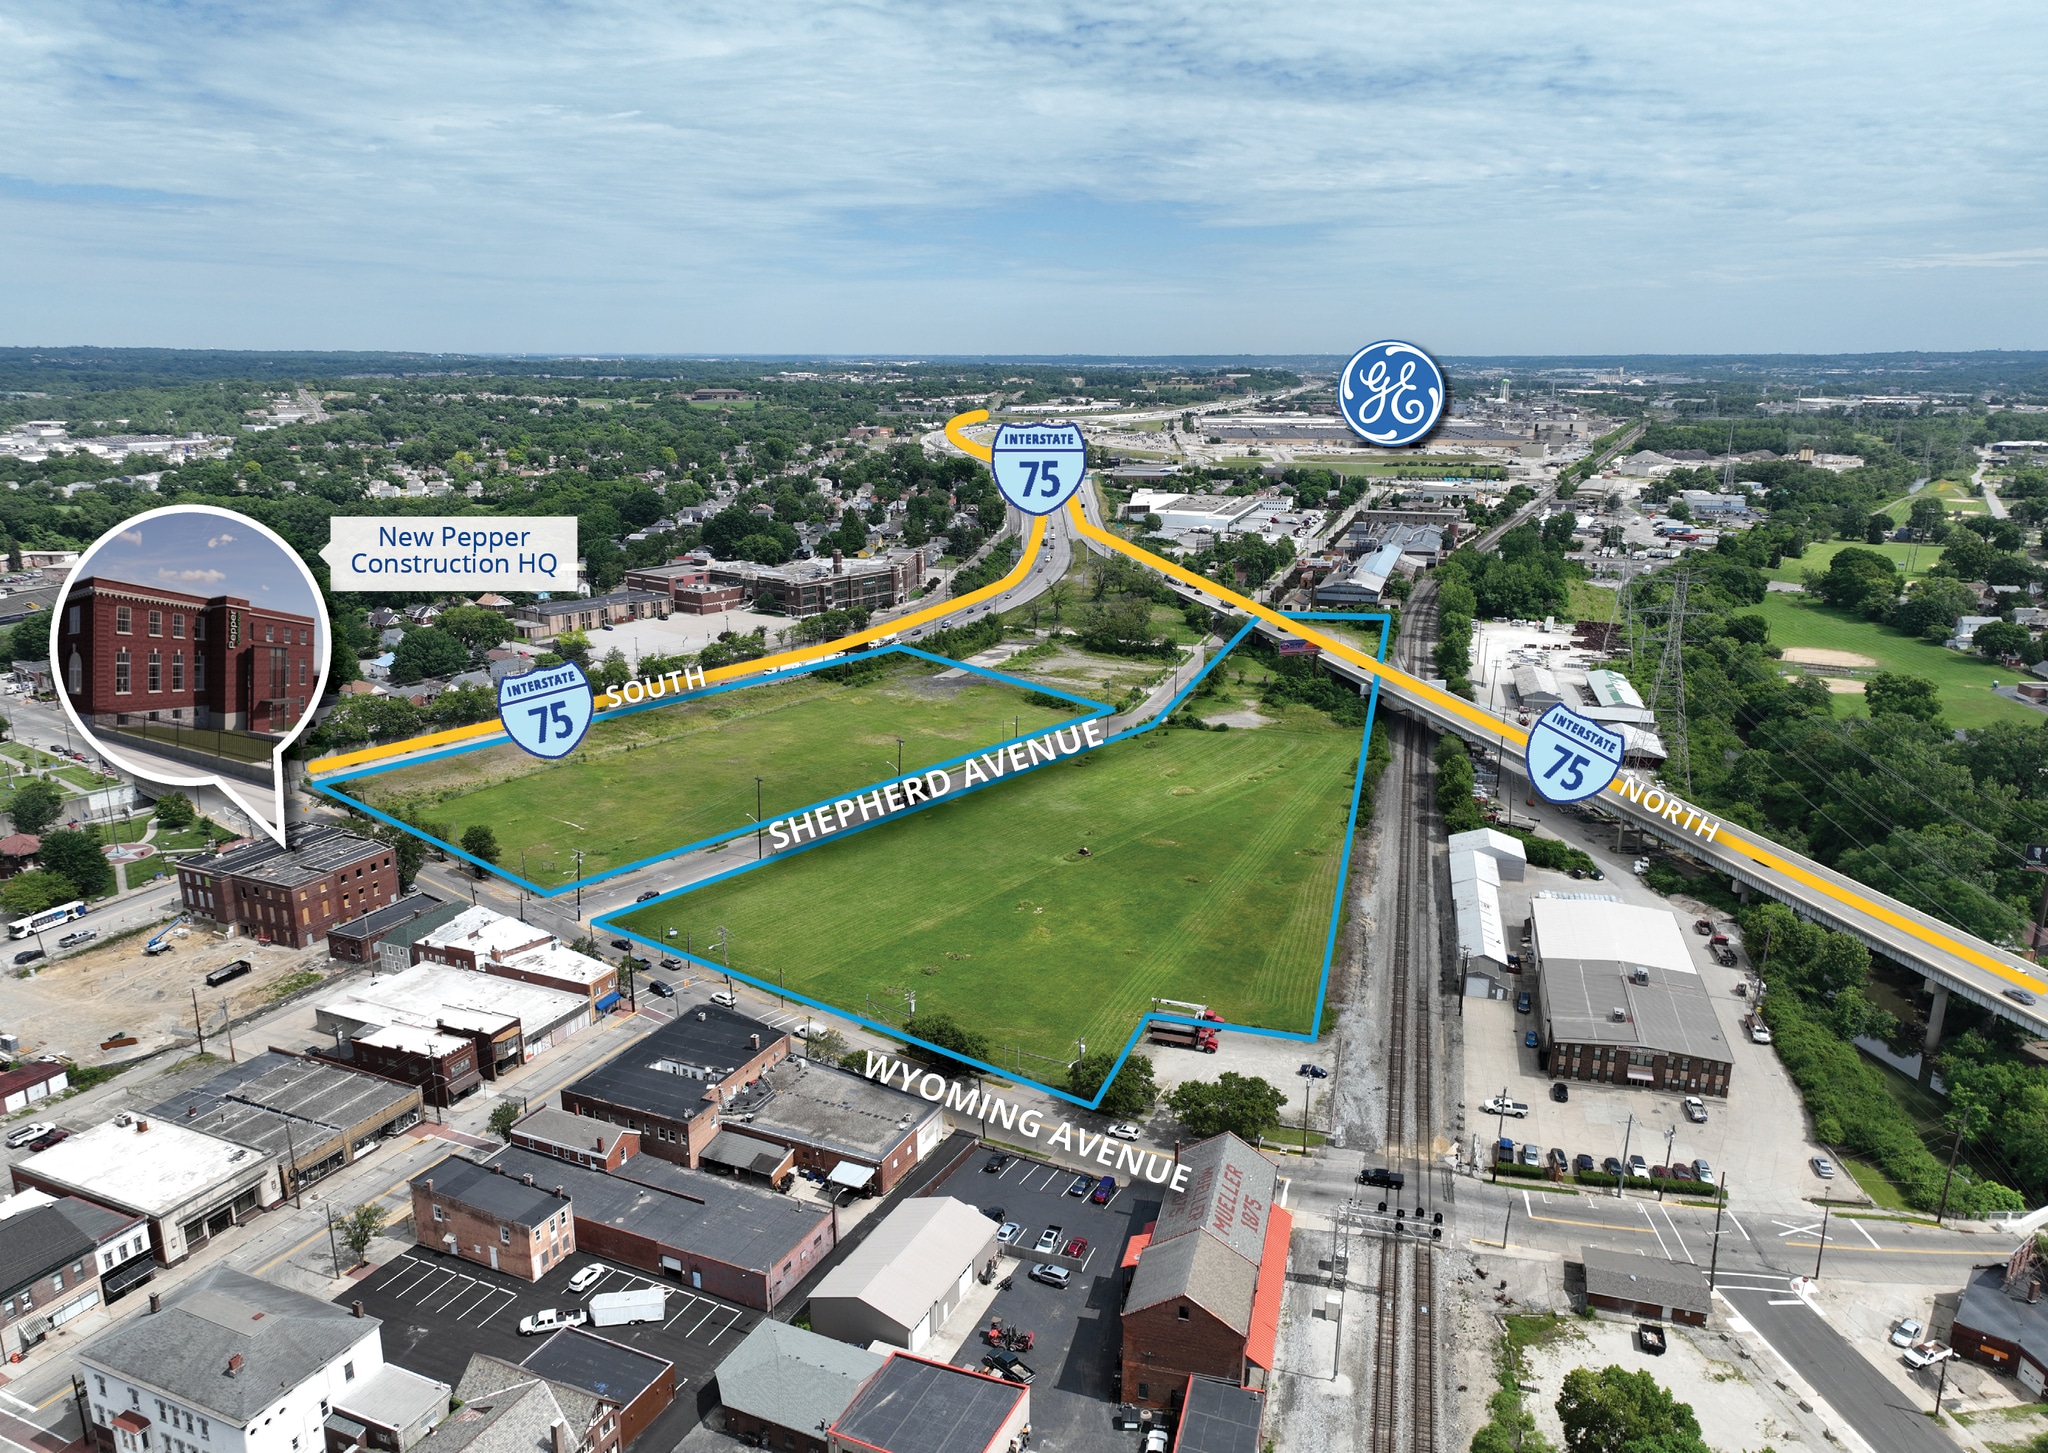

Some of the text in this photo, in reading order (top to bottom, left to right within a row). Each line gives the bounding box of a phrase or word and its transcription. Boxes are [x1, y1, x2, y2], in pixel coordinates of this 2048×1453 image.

[228, 609, 238, 649] Pepper
[1212, 1163, 1244, 1237] MUELLER
[1240, 1194, 1262, 1233] 1875
